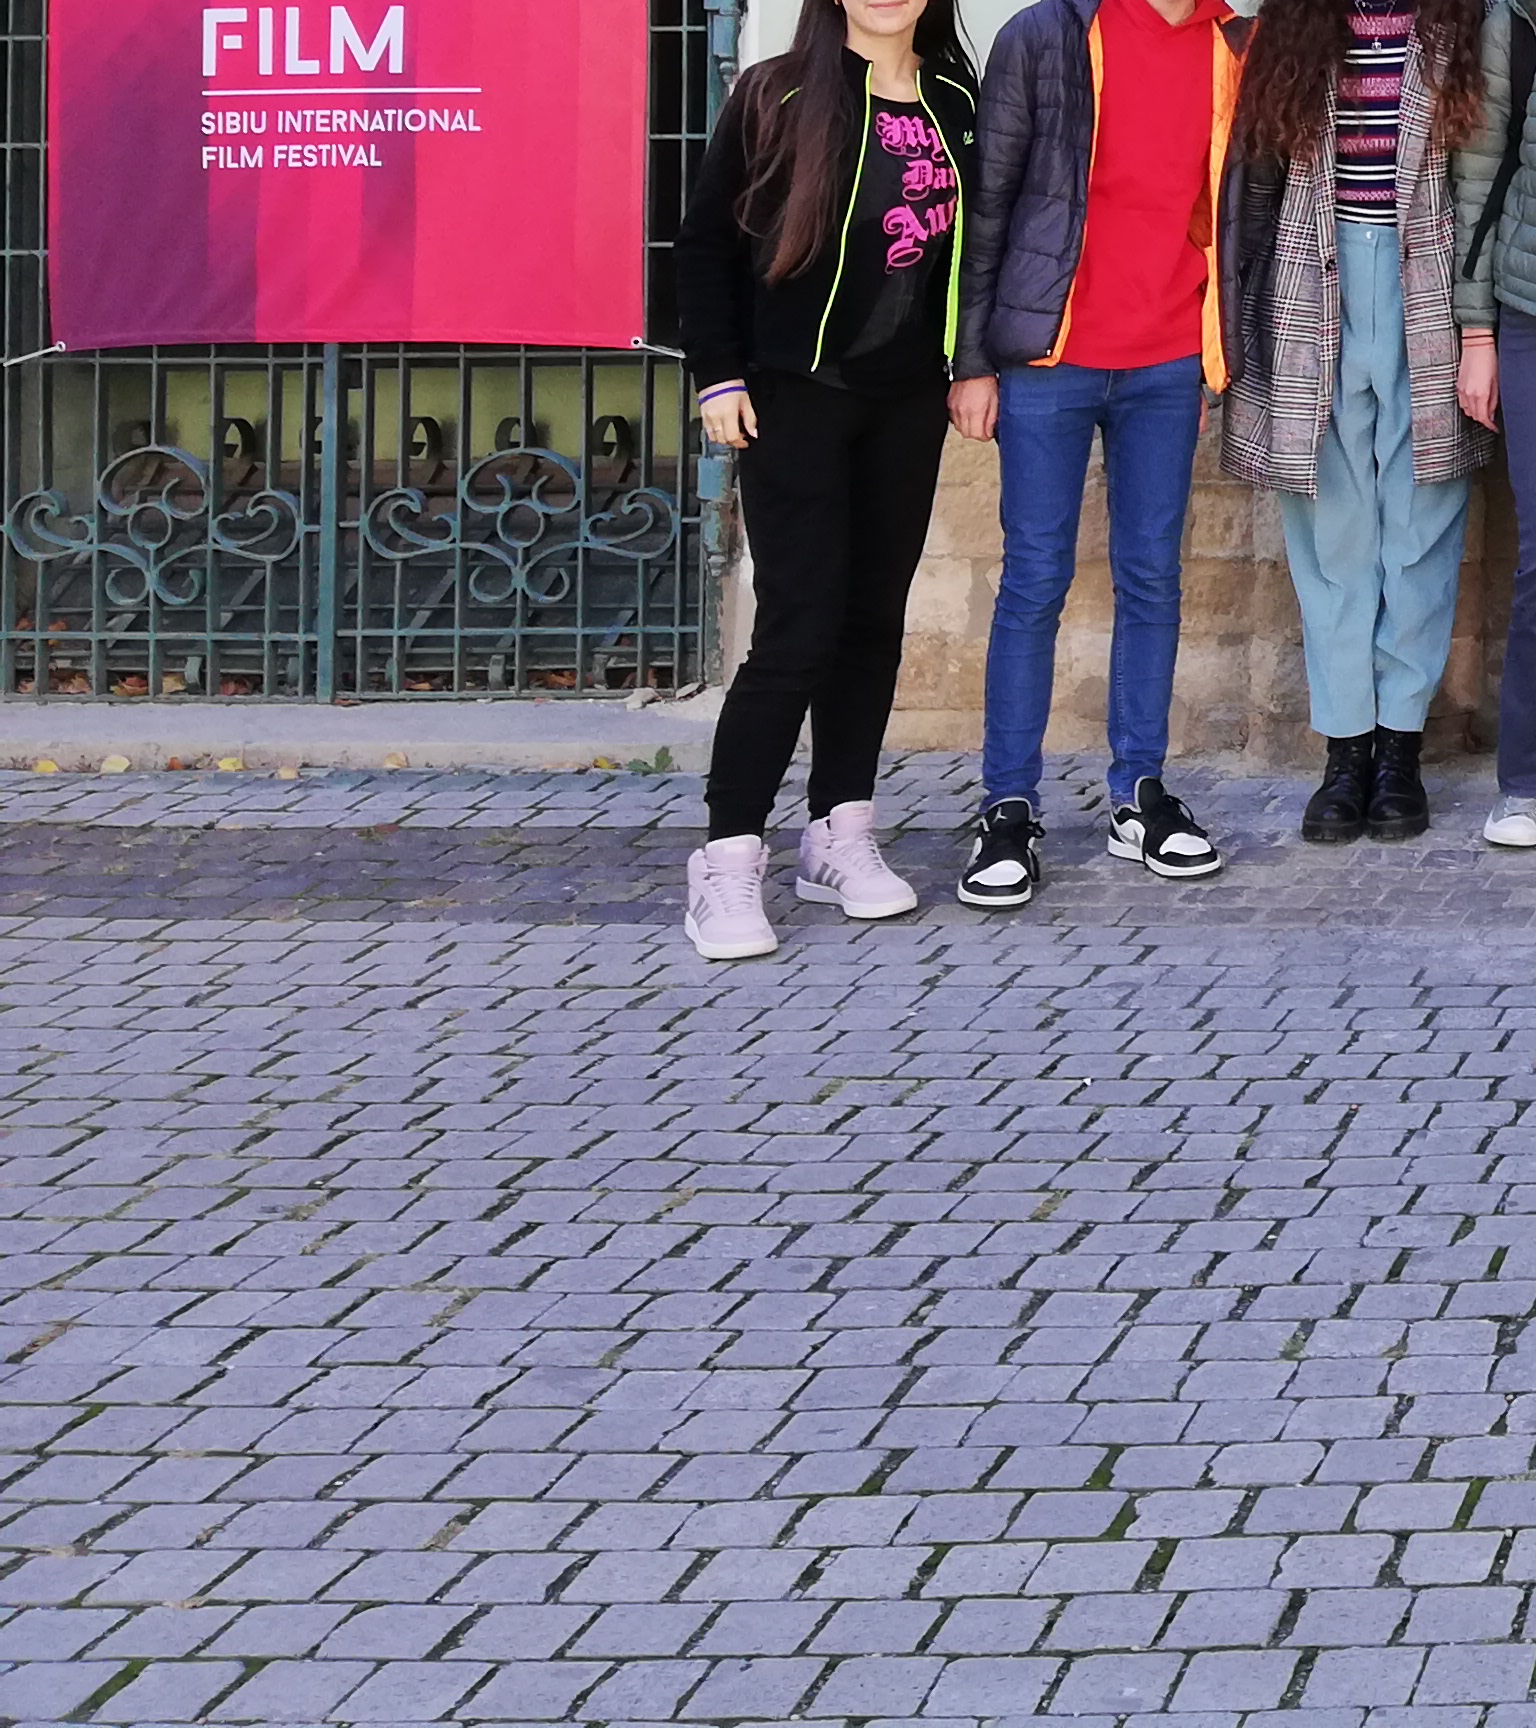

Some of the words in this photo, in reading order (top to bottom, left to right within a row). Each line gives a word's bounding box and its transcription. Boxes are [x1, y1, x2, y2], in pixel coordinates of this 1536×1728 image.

[203, 6, 404, 76] FILM
[202, 111, 266, 134] SIBIU
[278, 109, 481, 133] INTERNATIONAL
[203, 146, 263, 169] FILM
[274, 144, 382, 167] FESTIVAL
